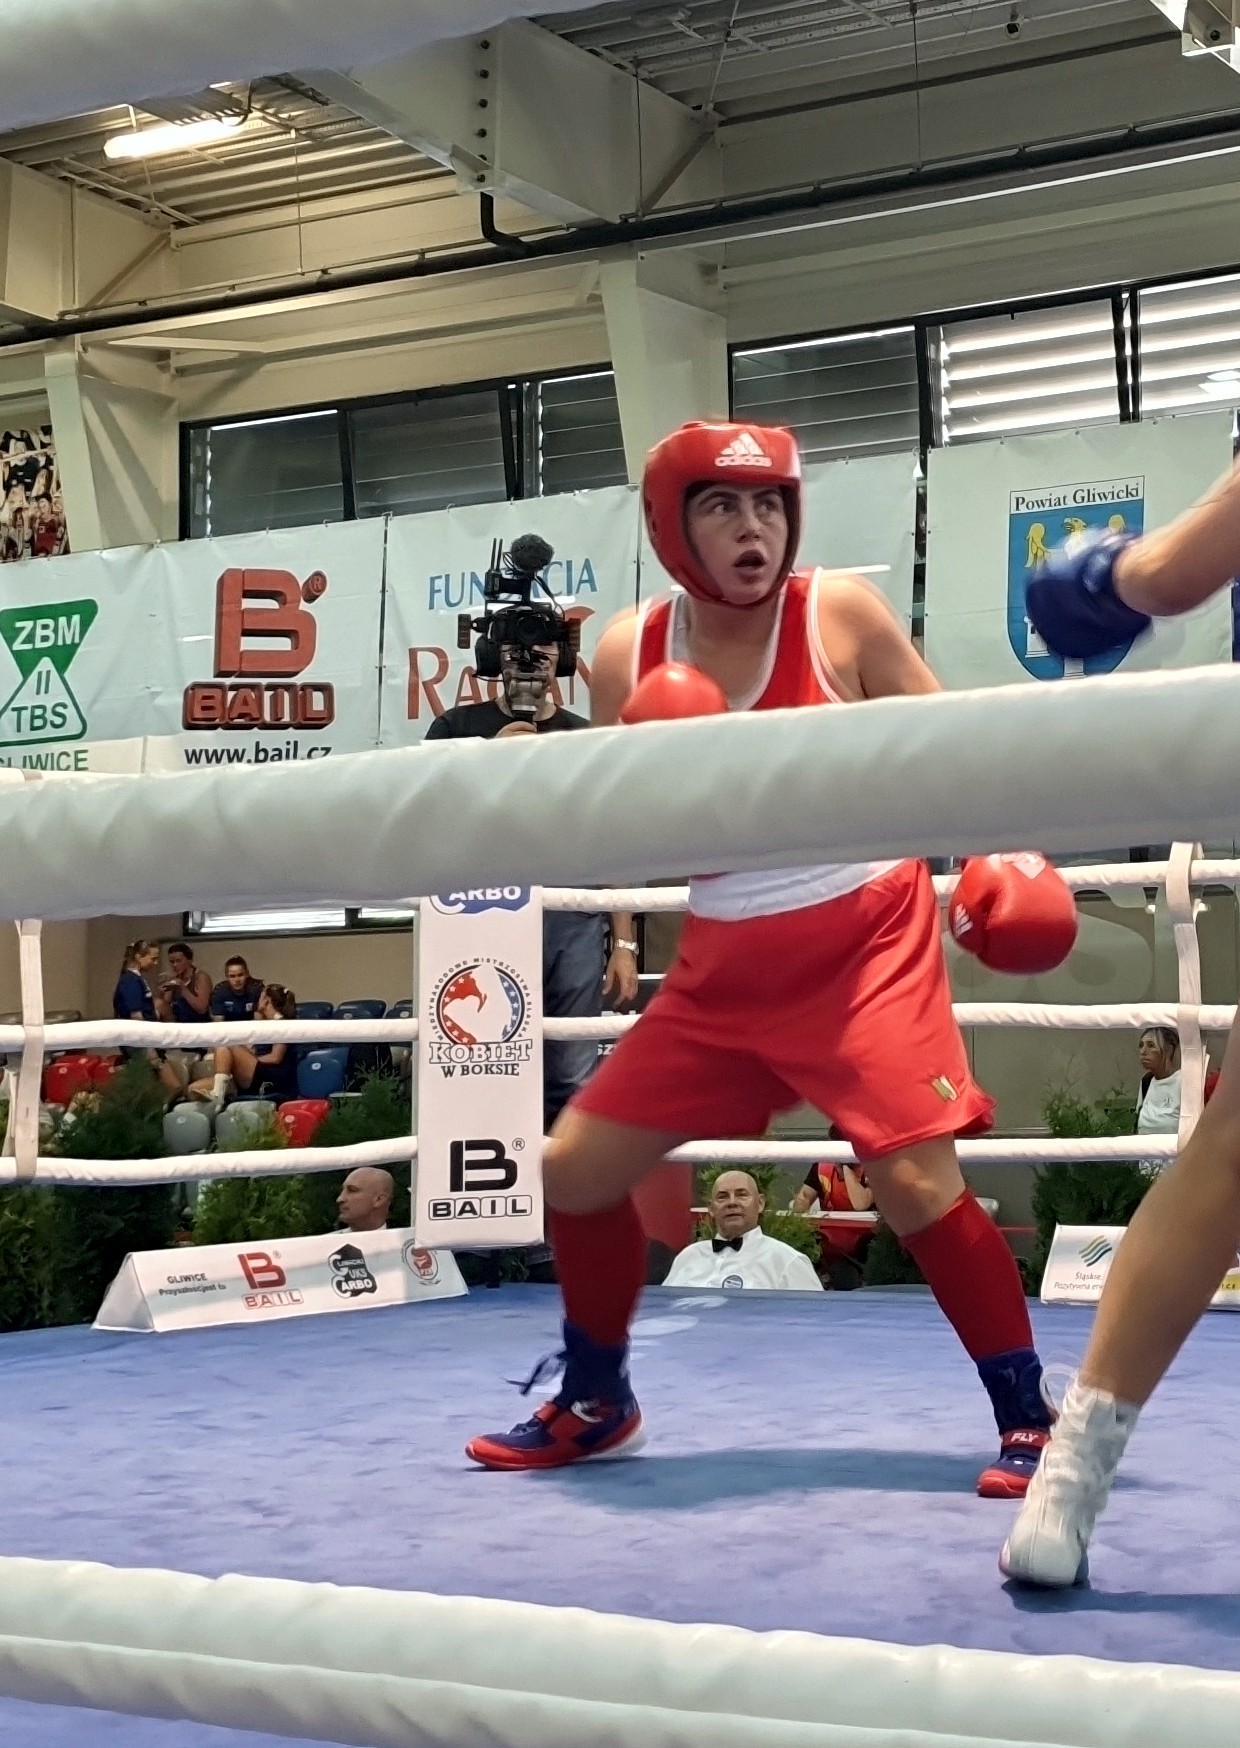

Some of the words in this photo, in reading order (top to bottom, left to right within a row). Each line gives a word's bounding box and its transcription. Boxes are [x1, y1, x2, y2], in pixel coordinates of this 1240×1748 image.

[1014, 493, 1068, 512] Powiat
[1072, 482, 1139, 504] Gliwicki
[12, 614, 81, 651] ZBM
[11, 702, 68, 733] TBS
[184, 684, 333, 728] BAIL
[429, 1039, 533, 1064] KOBIET
[441, 1065, 456, 1078] W
[460, 1063, 520, 1076] BOKSIE
[450, 1139, 518, 1192] B
[430, 1196, 530, 1219] BAIL
[243, 1290, 303, 1308] BAIL
[1011, 1432, 1039, 1443] FLY
